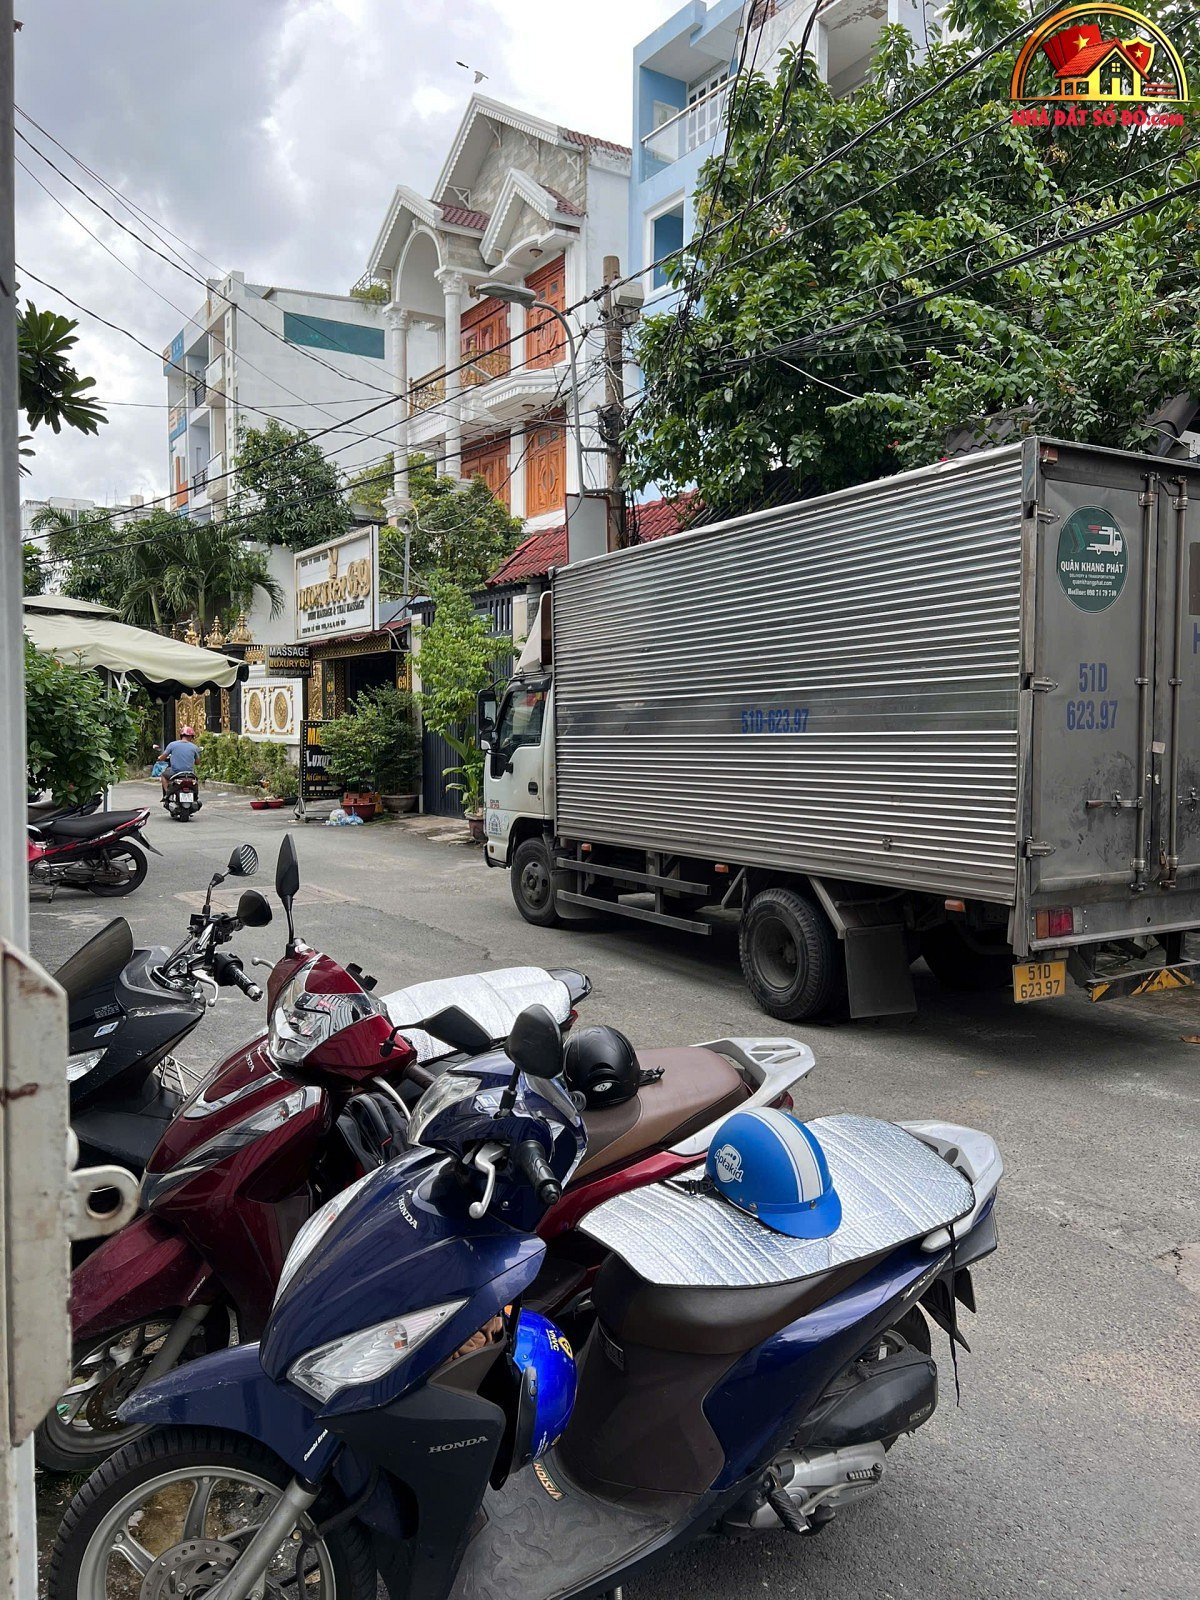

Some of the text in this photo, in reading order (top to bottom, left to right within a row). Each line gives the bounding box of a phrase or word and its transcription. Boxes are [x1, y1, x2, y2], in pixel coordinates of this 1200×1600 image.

[1060, 559, 1124, 573] QUÂN KHANG PHÁT
[269, 646, 310, 657] MASSAGE
[269, 659, 310, 668] LUXURY 69
[1078, 662, 1108, 693] 51D
[741, 707, 809, 734] 51D-623.97
[1066, 700, 1119, 731] 623.97
[1028, 964, 1051, 981] 51D
[1020, 980, 1061, 999] 623.97
[715, 1150, 743, 1180] Aptakid
[398, 1197, 418, 1230] HONDA
[428, 1436, 489, 1454] HONDA
[532, 1462, 564, 1502] VISION
